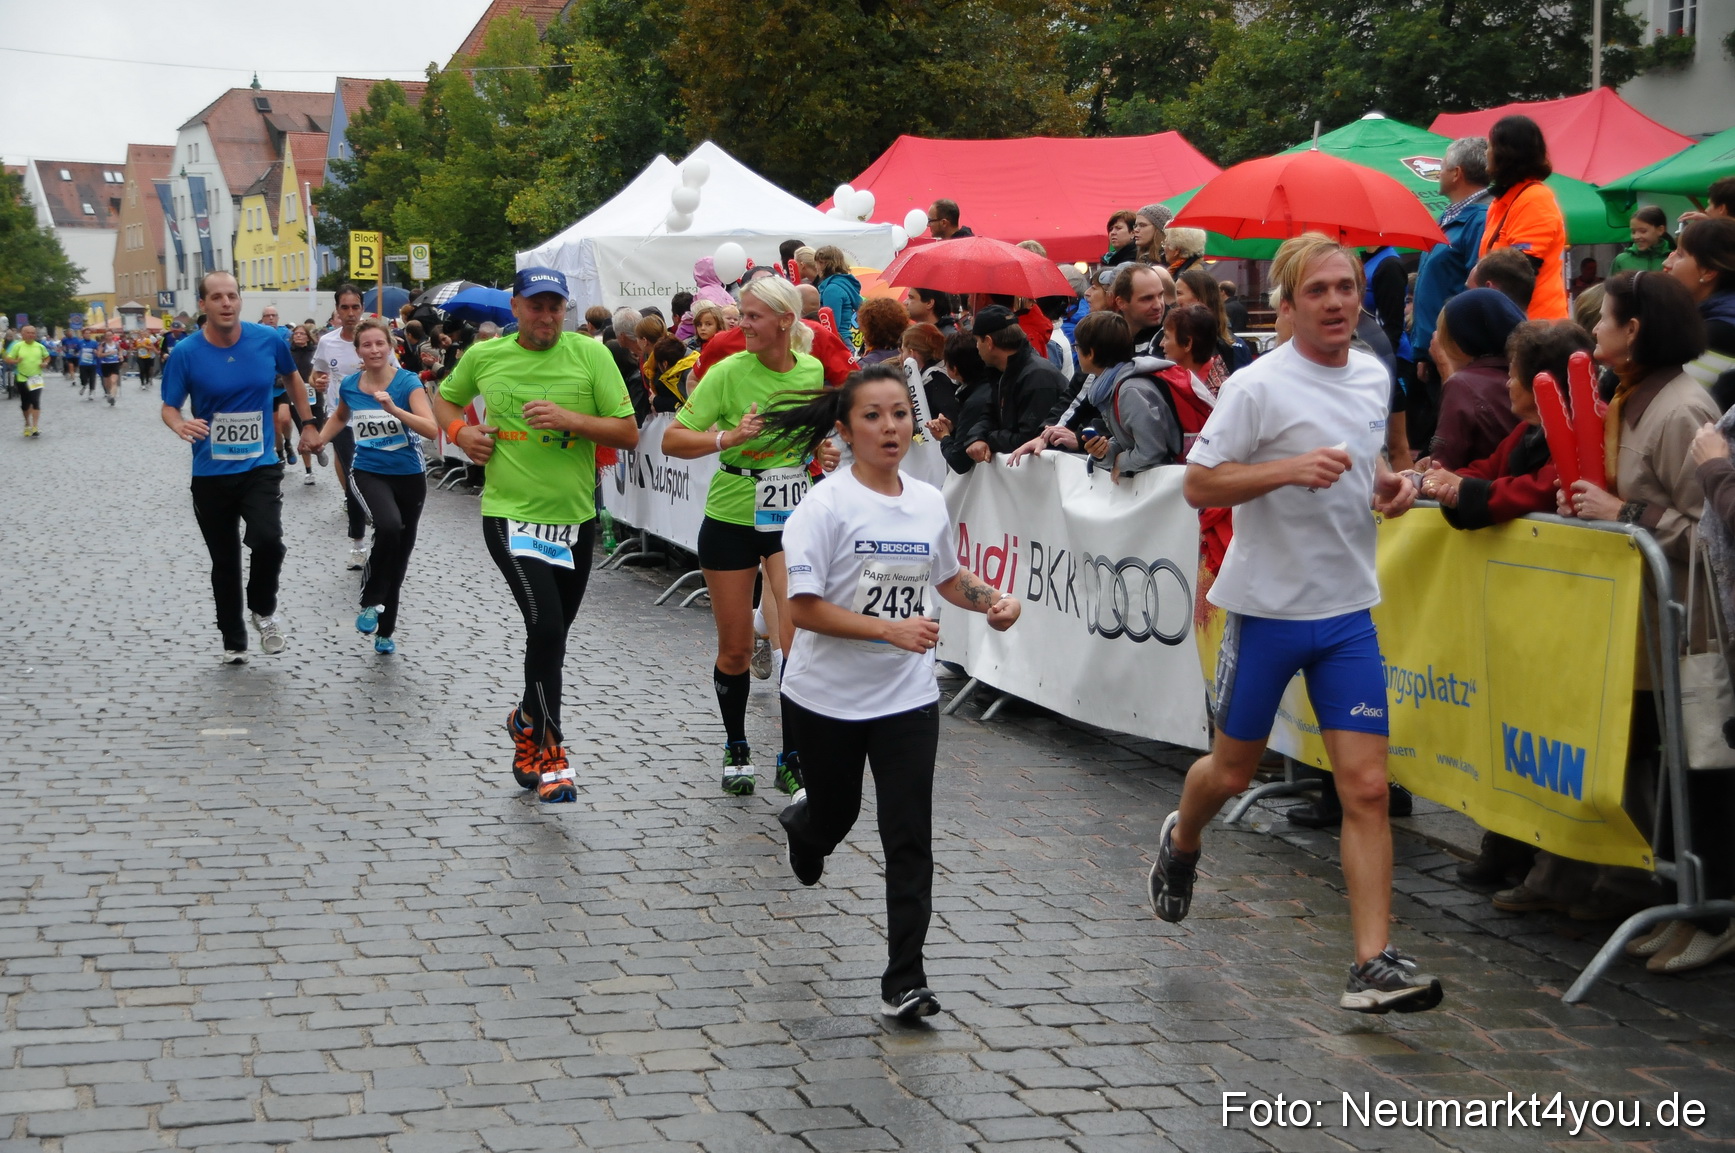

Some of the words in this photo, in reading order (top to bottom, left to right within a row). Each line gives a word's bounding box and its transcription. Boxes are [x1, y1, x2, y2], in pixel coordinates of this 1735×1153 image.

[354, 233, 379, 243] Block
[359, 246, 374, 268] B
[619, 281, 671, 297] Kinder
[676, 280, 699, 295] bra
[216, 423, 259, 442] 2620
[357, 420, 399, 438] 2619
[370, 437, 394, 448] Sandra
[771, 513, 787, 522] The
[533, 540, 557, 557] Benno
[881, 542, 928, 553] BÜSCHEL
[863, 569, 890, 582] PARTL
[957, 522, 1018, 594] Audi
[1026, 540, 1081, 619] BKK
[862, 585, 925, 619] 2434
[1362, 707, 1383, 717] asics
[1501, 721, 1586, 802] KANN
